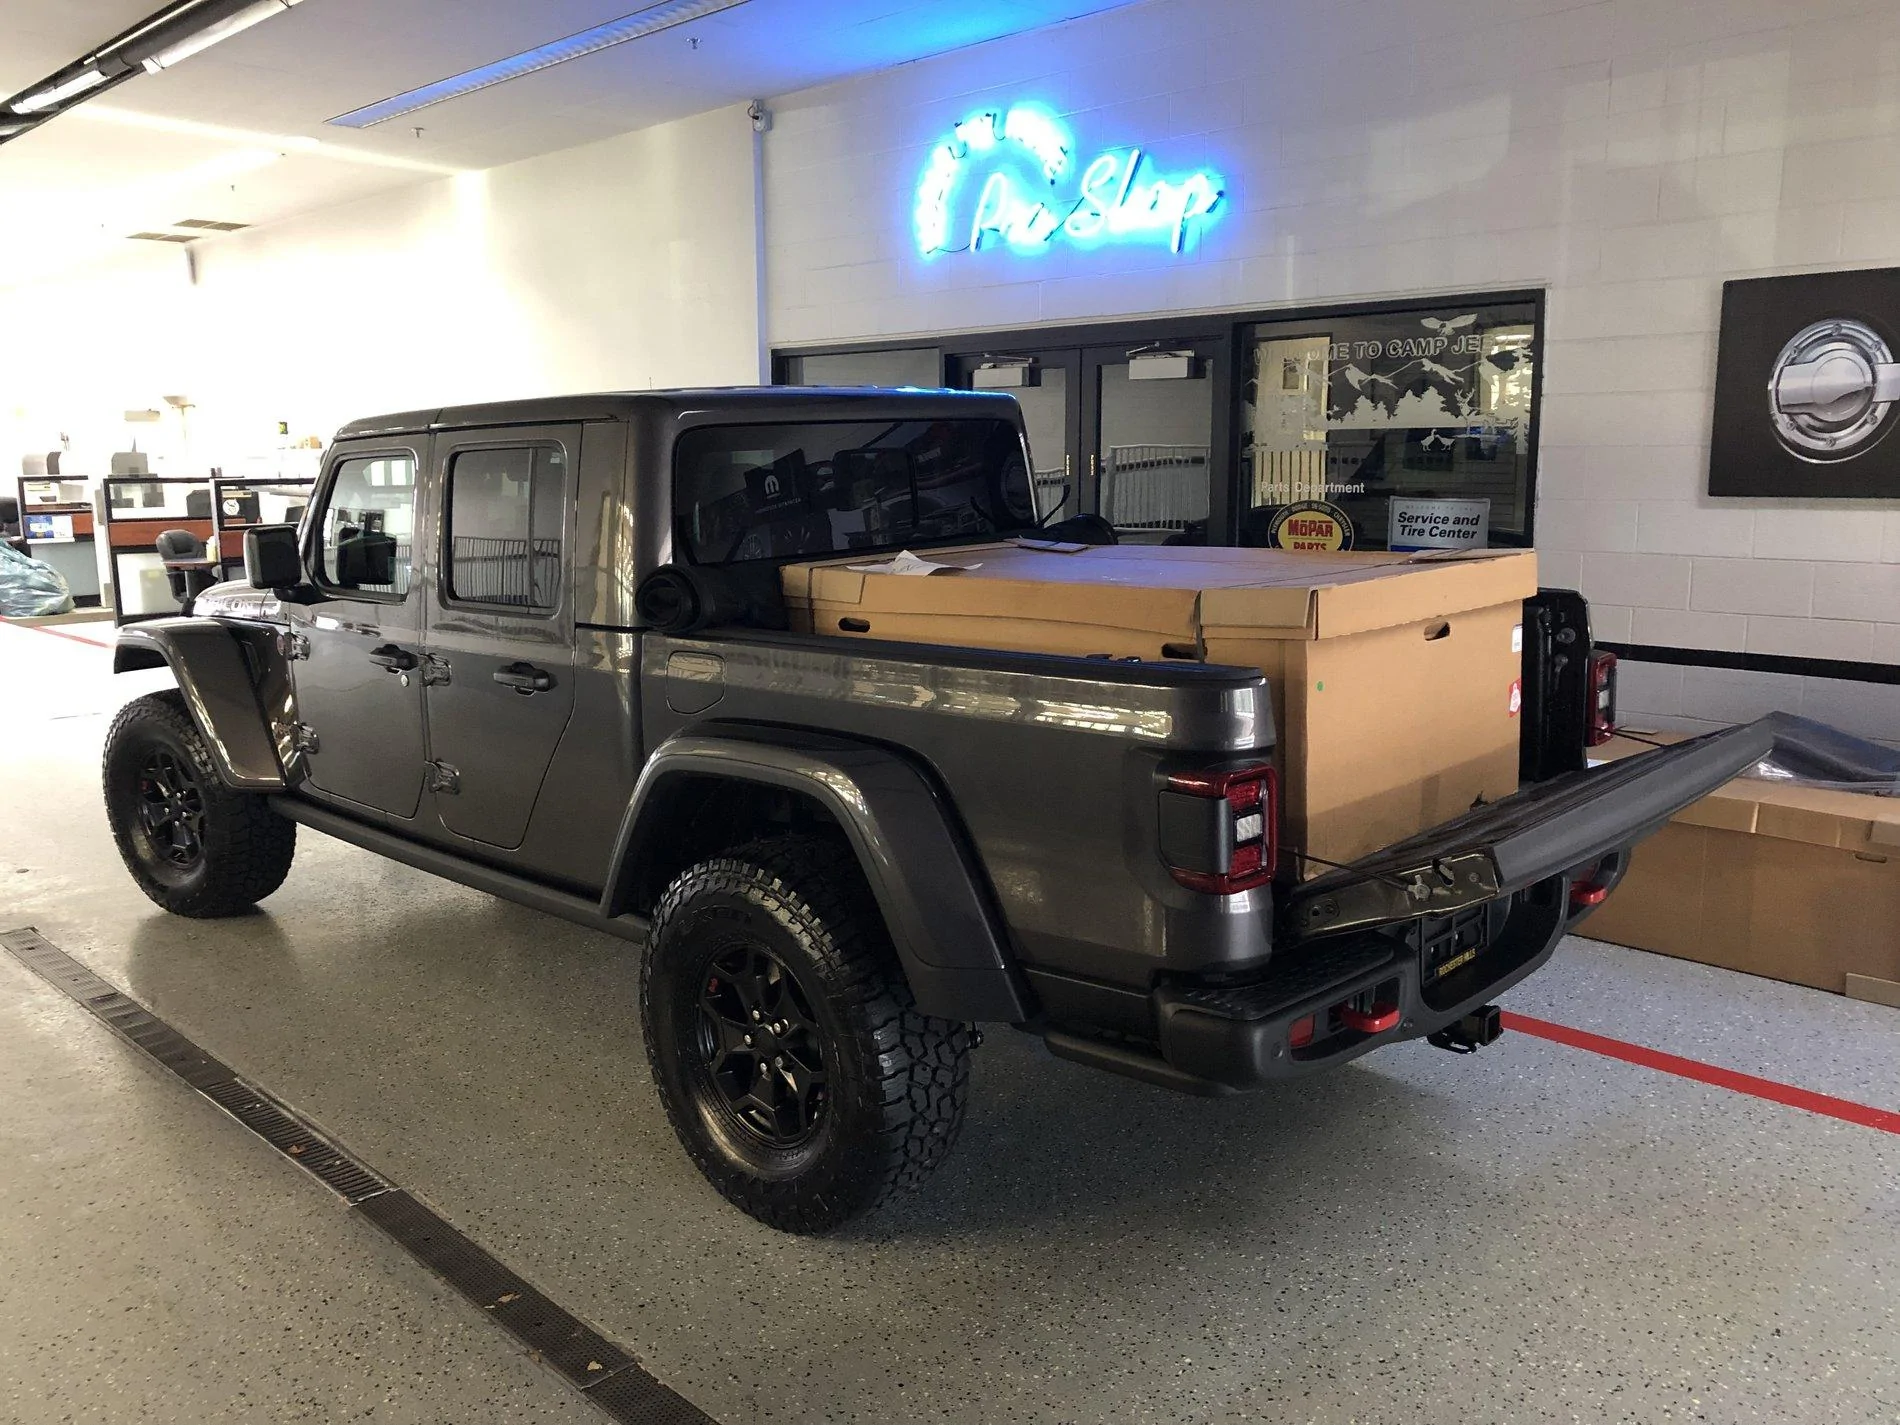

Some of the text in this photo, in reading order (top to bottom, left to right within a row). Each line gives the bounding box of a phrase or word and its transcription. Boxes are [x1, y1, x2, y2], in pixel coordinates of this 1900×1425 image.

[1064, 148, 1225, 254] Shop
[1354, 340, 1383, 360] TO
[1386, 336, 1448, 358] CAMP
[1261, 481, 1365, 496] Parts Department
[1397, 511, 1480, 526] Service and
[1287, 519, 1334, 537] MOPAR
[1399, 524, 1477, 539] Tire Center
[1293, 541, 1327, 550] PARTS
